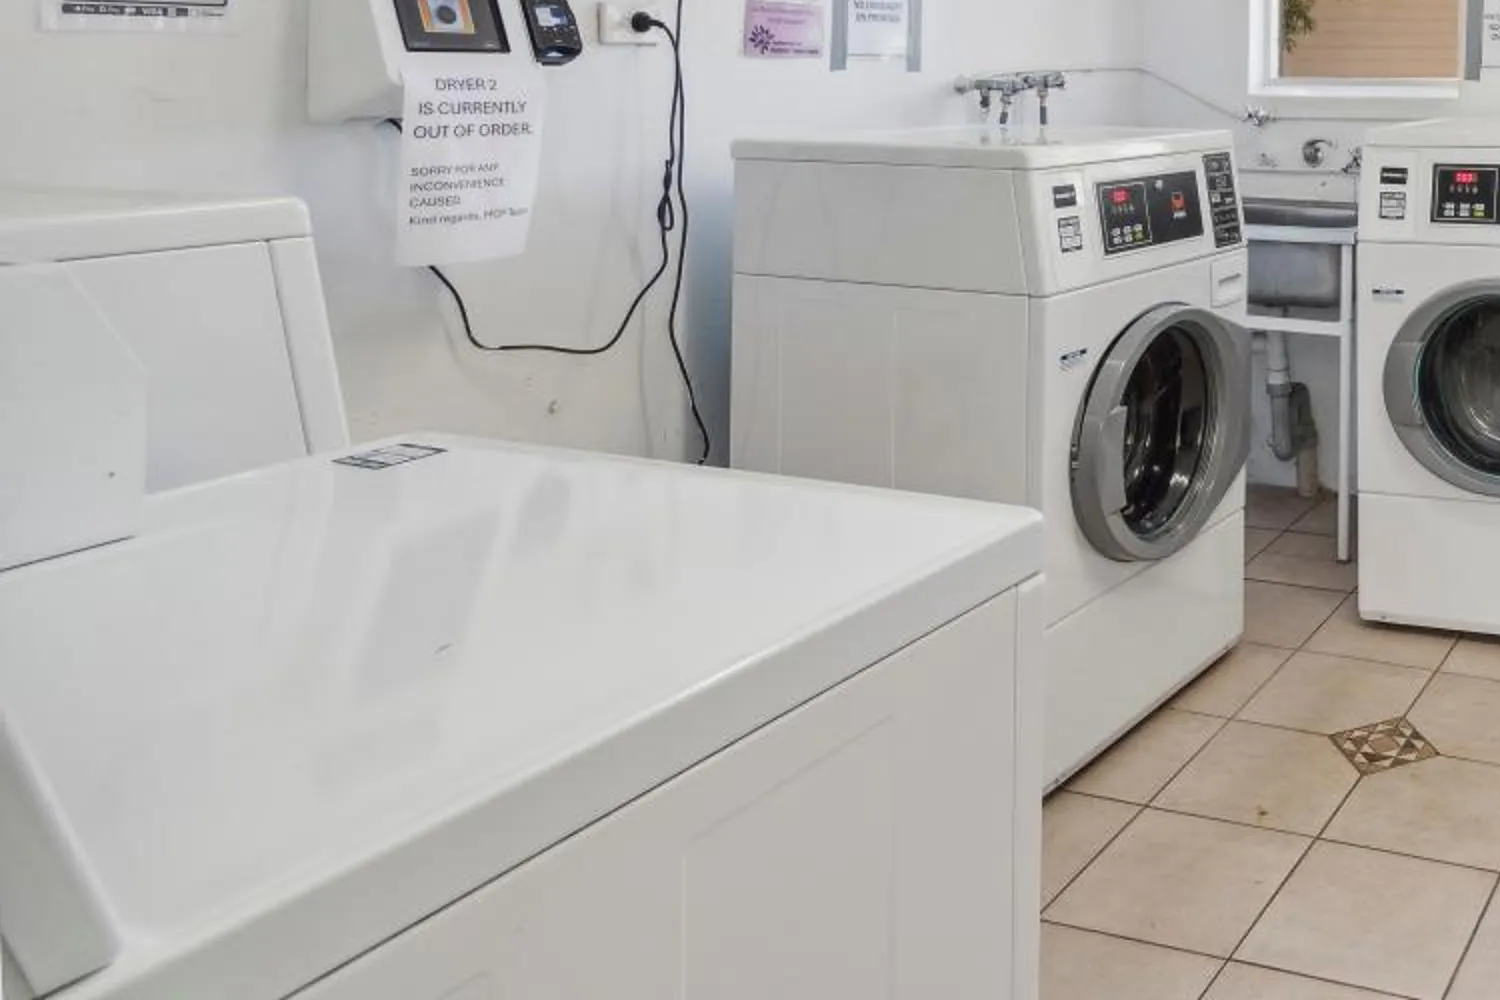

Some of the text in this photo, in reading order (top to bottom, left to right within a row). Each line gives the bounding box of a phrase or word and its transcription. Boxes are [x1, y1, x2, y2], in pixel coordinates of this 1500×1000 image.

[435, 78, 497, 91] DRYER 2
[419, 101, 527, 115] IS CURRENTLY
[413, 125, 449, 139] OUT
[453, 124, 476, 138] OF
[411, 166, 451, 177] SORRY
[410, 178, 504, 192] INCONVENIENCE
